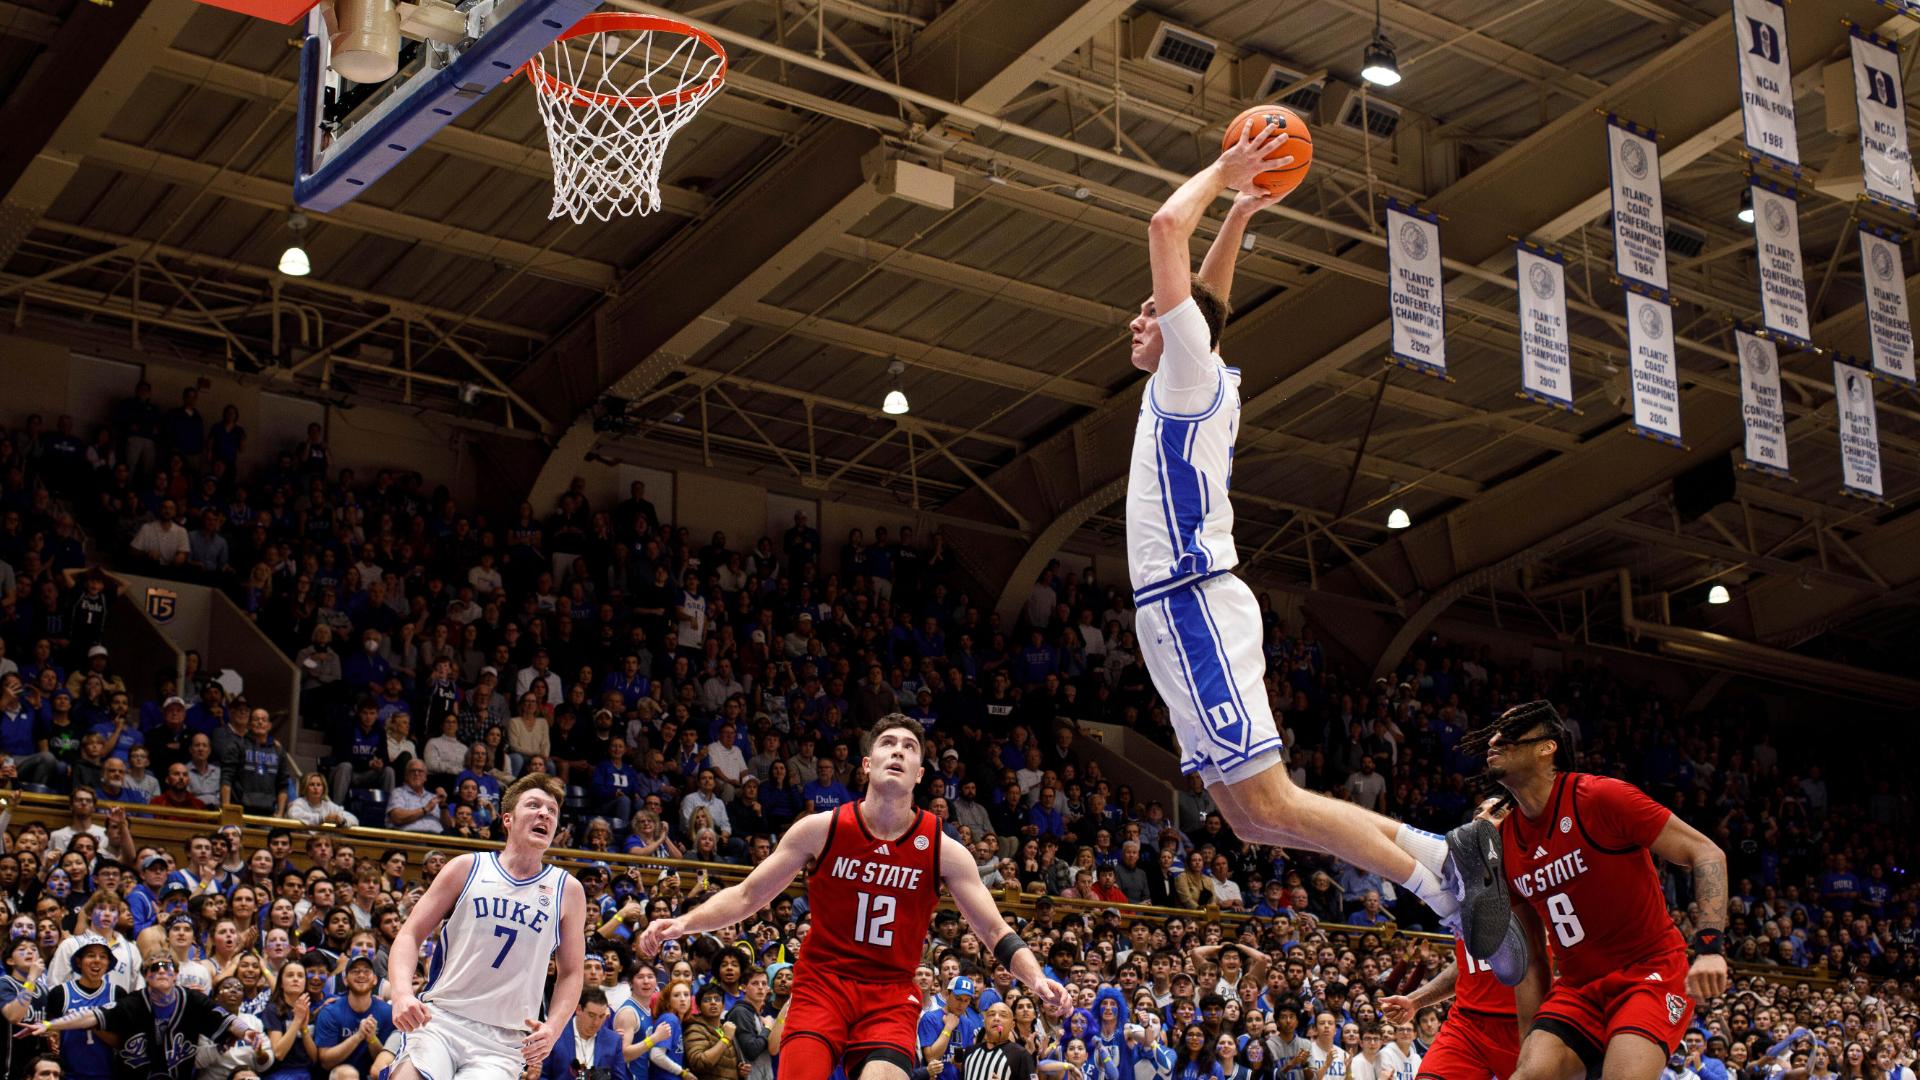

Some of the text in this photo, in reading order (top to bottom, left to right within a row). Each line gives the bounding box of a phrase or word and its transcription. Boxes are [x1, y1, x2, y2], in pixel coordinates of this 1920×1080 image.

[1756, 75, 1780, 95] NCAA
[1745, 92, 1794, 120] FINAL FOUR
[1874, 120, 1897, 138] NCAA
[1763, 131, 1784, 149] 1988
[1865, 136, 1886, 153] FINAL
[1622, 185, 1653, 207] ATLANTIC
[1627, 201, 1650, 218] COAST
[1616, 211, 1663, 237] CONFERENCE
[1619, 225, 1662, 250] CHAMPIONS
[1765, 243, 1795, 263] ATLANTIC
[1633, 260, 1653, 277] 1964
[1771, 258, 1792, 273] COAST
[1399, 268, 1435, 288] ATLANTIC
[1762, 267, 1804, 290] CONFERENCE
[1406, 282, 1429, 299] COAST
[1766, 281, 1804, 303] CHAMPIONS
[1873, 286, 1901, 305] ATLANTIC
[1393, 292, 1441, 317] CONFERENCE
[1879, 301, 1898, 317] COAST
[1395, 306, 1440, 330] CHAMPIONS
[1528, 309, 1561, 327] ATLANTIC
[1780, 313, 1799, 329] 1965
[1870, 310, 1911, 331] CONFERENCE
[1534, 323, 1556, 338] COAST
[1874, 324, 1910, 344] CHAMPIONS
[1410, 339, 1431, 355] 2002
[1523, 332, 1568, 354] CONFERENCE
[1526, 345, 1567, 366] CHAMPIONS
[1638, 346, 1668, 363] ATLANTIC
[1885, 356, 1902, 370] 1966
[1644, 360, 1665, 374] COAST
[1539, 376, 1557, 389] 2003
[1634, 369, 1676, 390] CONFERENCE
[1637, 382, 1676, 402] CHAMPIONS
[1649, 412, 1668, 426] 2004
[152, 597, 173, 617] 15
[87, 611, 92, 624] 1
[816, 795, 839, 804] Duke
[831, 856, 923, 890] NC STATE
[1514, 848, 1589, 897] NC STATE
[1833, 879, 1853, 889] DUKE
[473, 897, 549, 934] DUKE
[854, 891, 897, 947] 12
[1547, 892, 1585, 948] 8
[491, 924, 518, 969] 7
[962, 980, 971, 990] D
